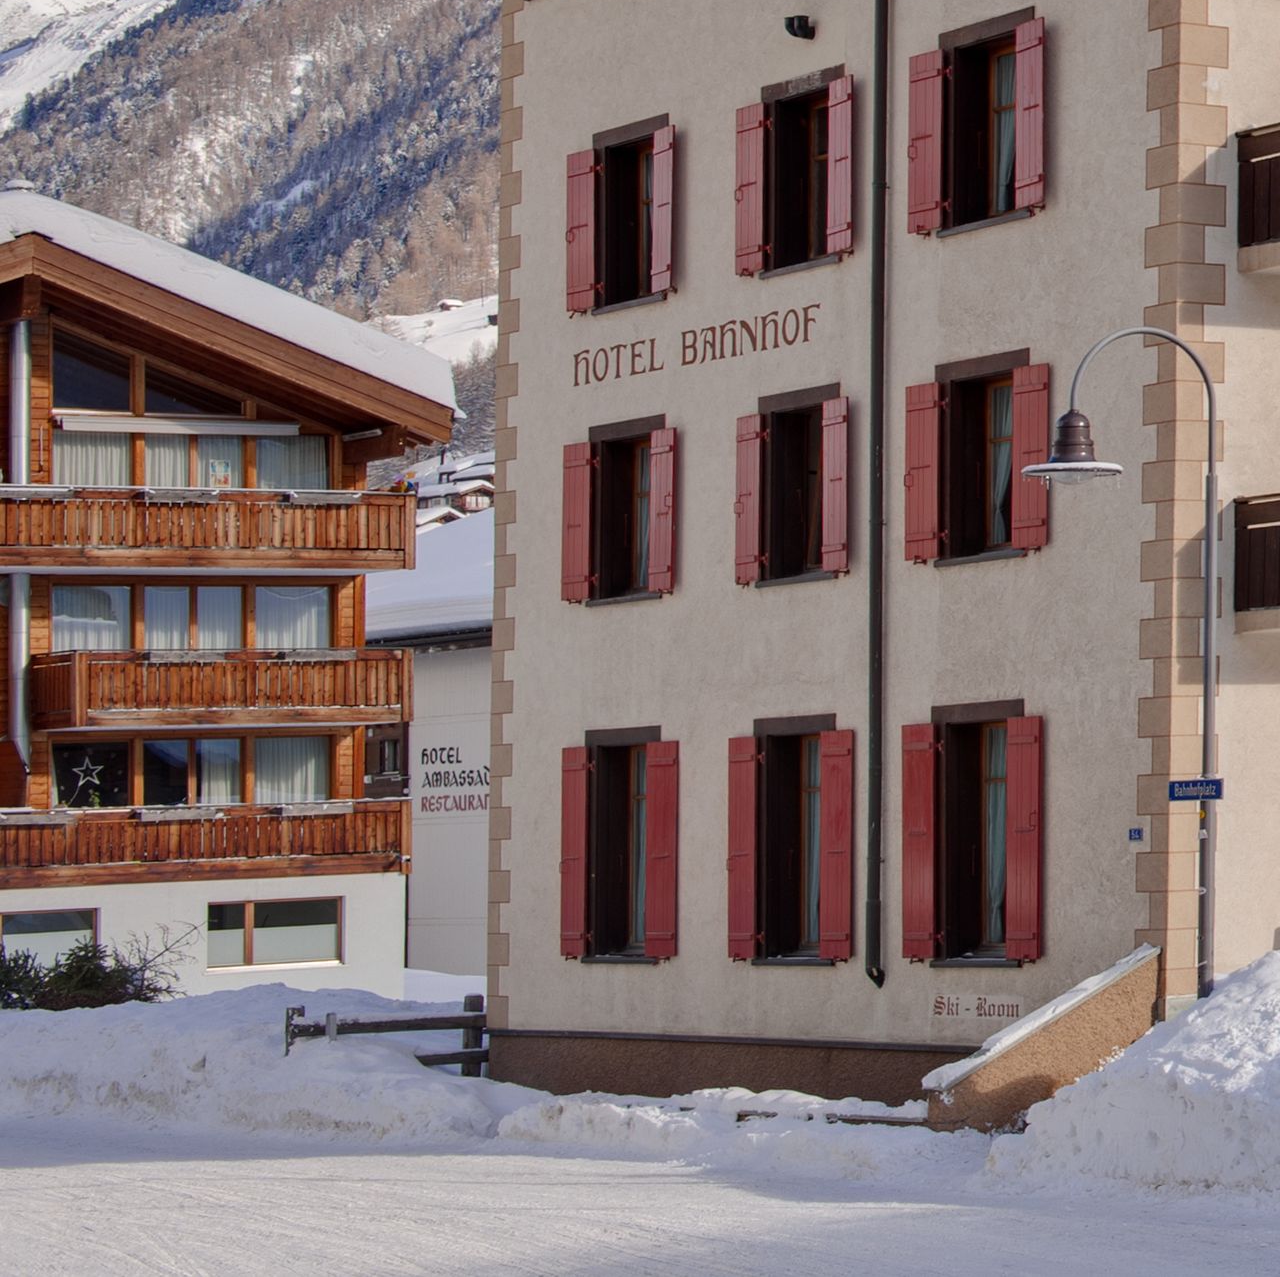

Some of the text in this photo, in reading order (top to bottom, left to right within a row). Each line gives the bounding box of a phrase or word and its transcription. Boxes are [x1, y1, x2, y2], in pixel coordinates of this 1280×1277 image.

[573, 303, 820, 387] HOTEL BAHNHOF
[421, 747, 462, 765] HOTEL
